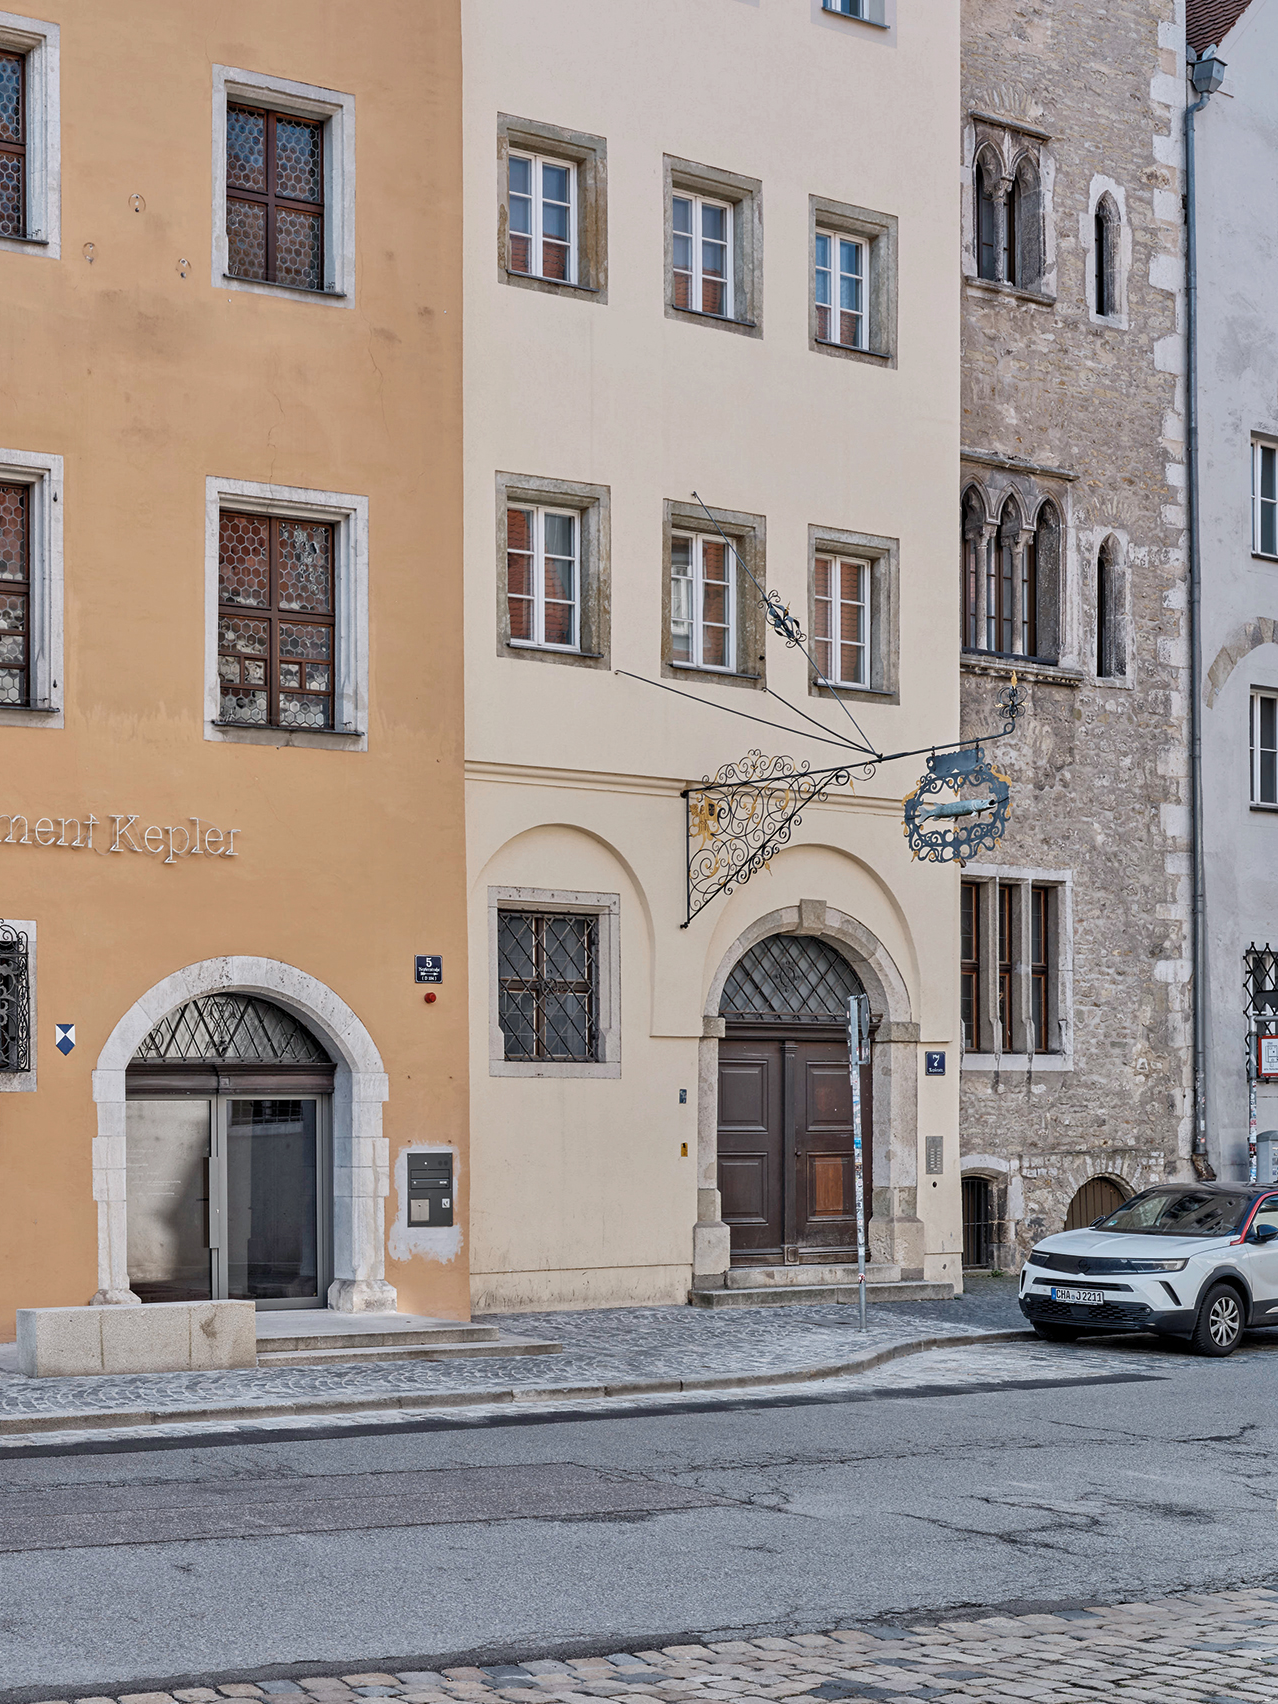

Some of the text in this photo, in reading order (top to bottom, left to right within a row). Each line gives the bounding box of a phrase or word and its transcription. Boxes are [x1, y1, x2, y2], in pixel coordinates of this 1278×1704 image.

[108, 813, 242, 864] Kepler
[425, 957, 433, 968] 5
[932, 1054, 940, 1067] 7
[1056, 1290, 1071, 1299] CHA
